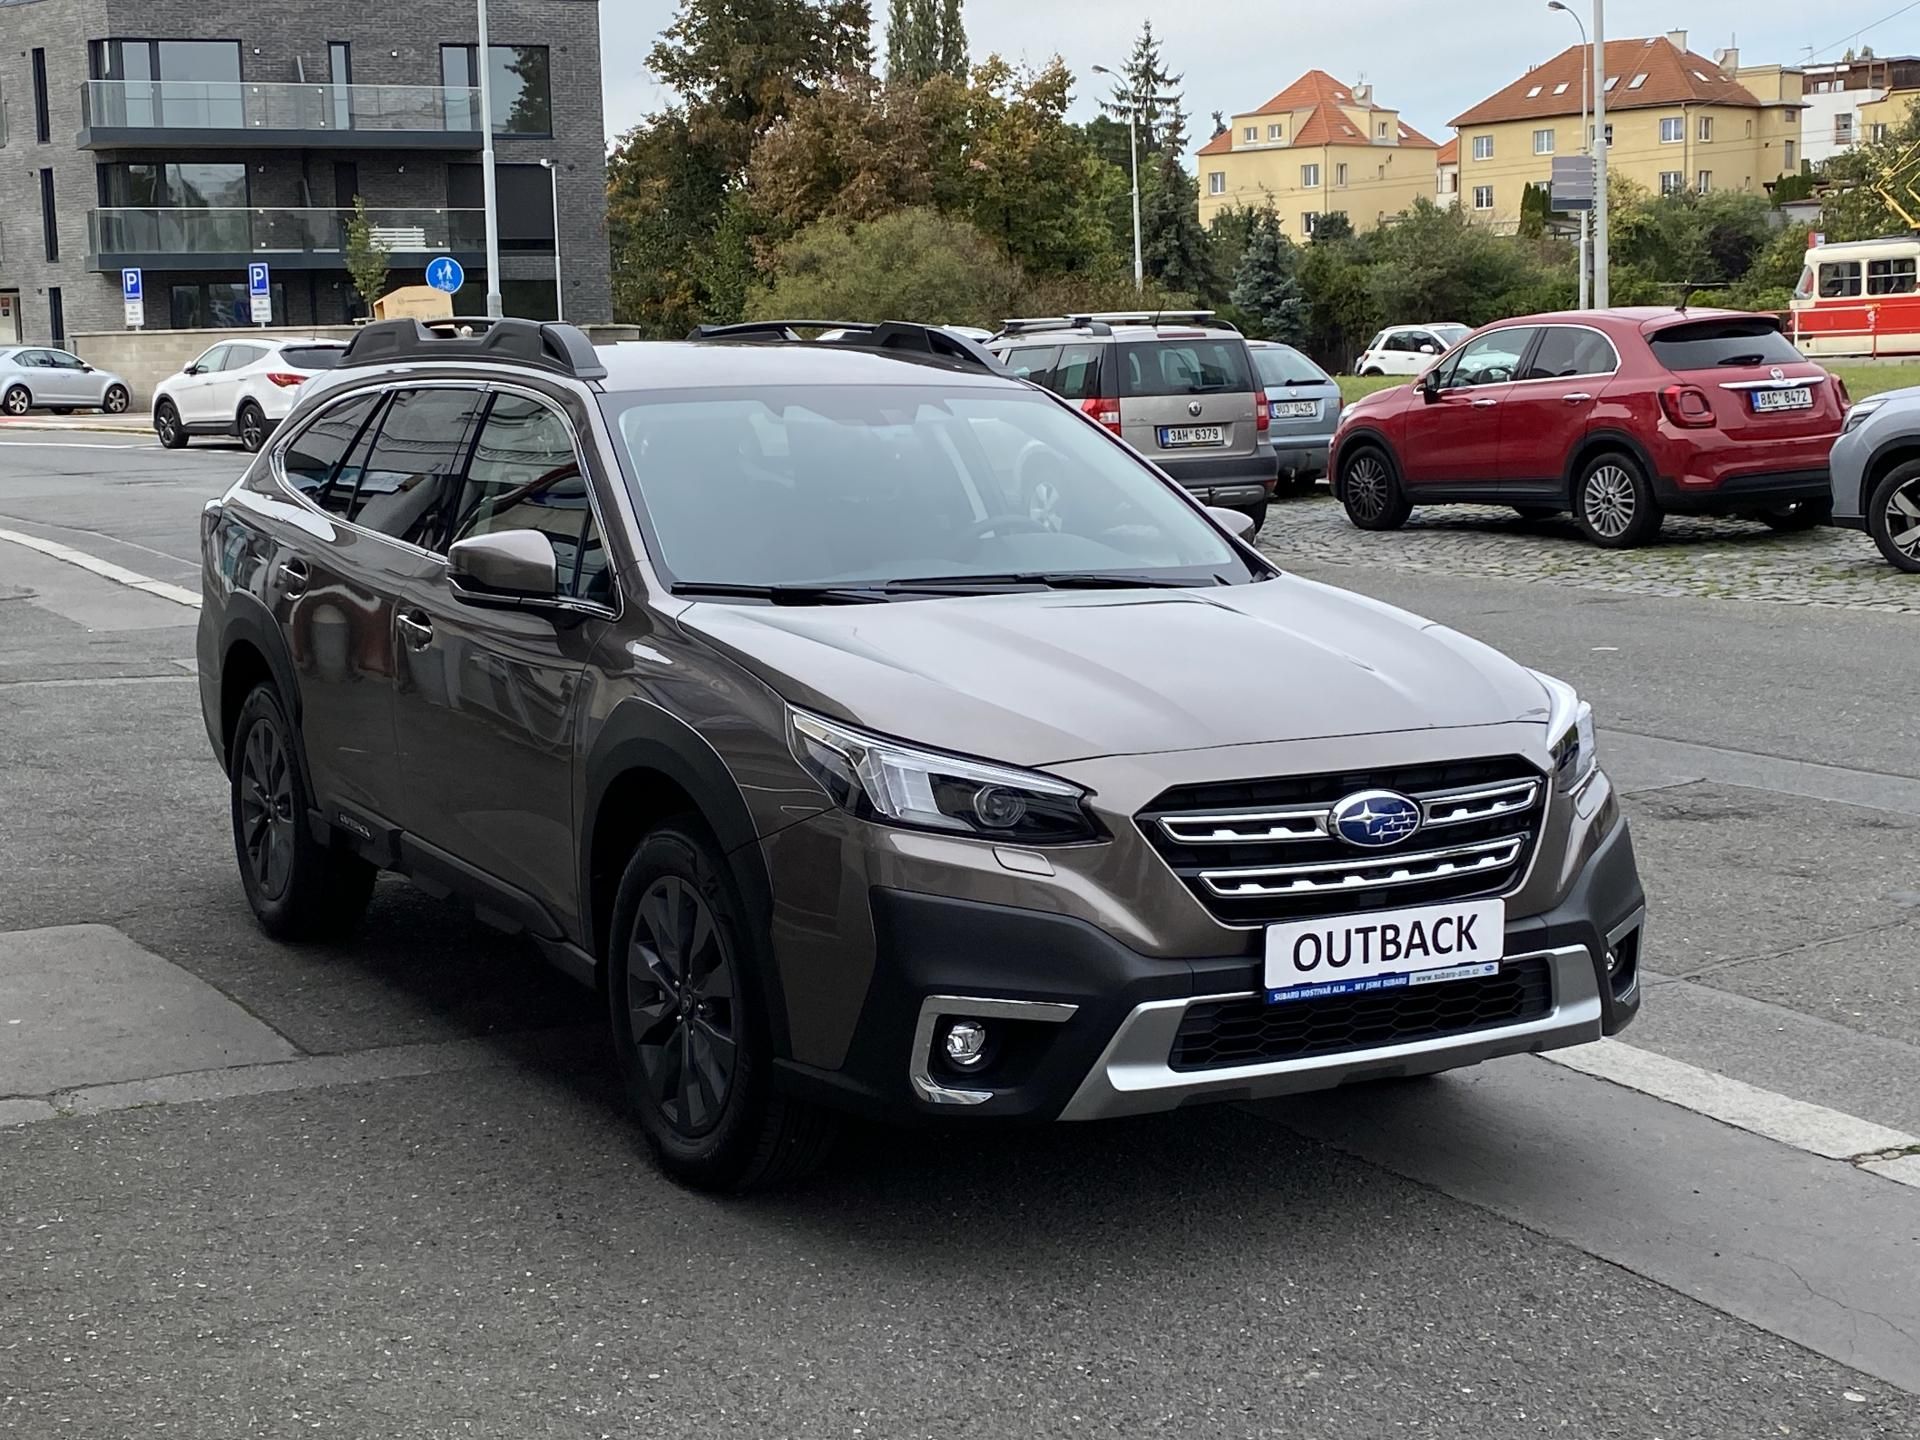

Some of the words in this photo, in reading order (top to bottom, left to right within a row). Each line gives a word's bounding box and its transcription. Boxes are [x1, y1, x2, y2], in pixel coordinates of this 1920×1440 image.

[126, 273, 137, 291] P
[253, 268, 264, 287] P
[1760, 392, 1778, 405] 8AC
[1784, 390, 1807, 403] 8472
[1170, 428, 1189, 441] 3AH
[1195, 428, 1219, 440] 6379
[1293, 913, 1478, 972] OUTBACK
[1274, 990, 1300, 1001] SUBARU
[1332, 985, 1346, 993] ALM
[1355, 982, 1365, 991] MY
